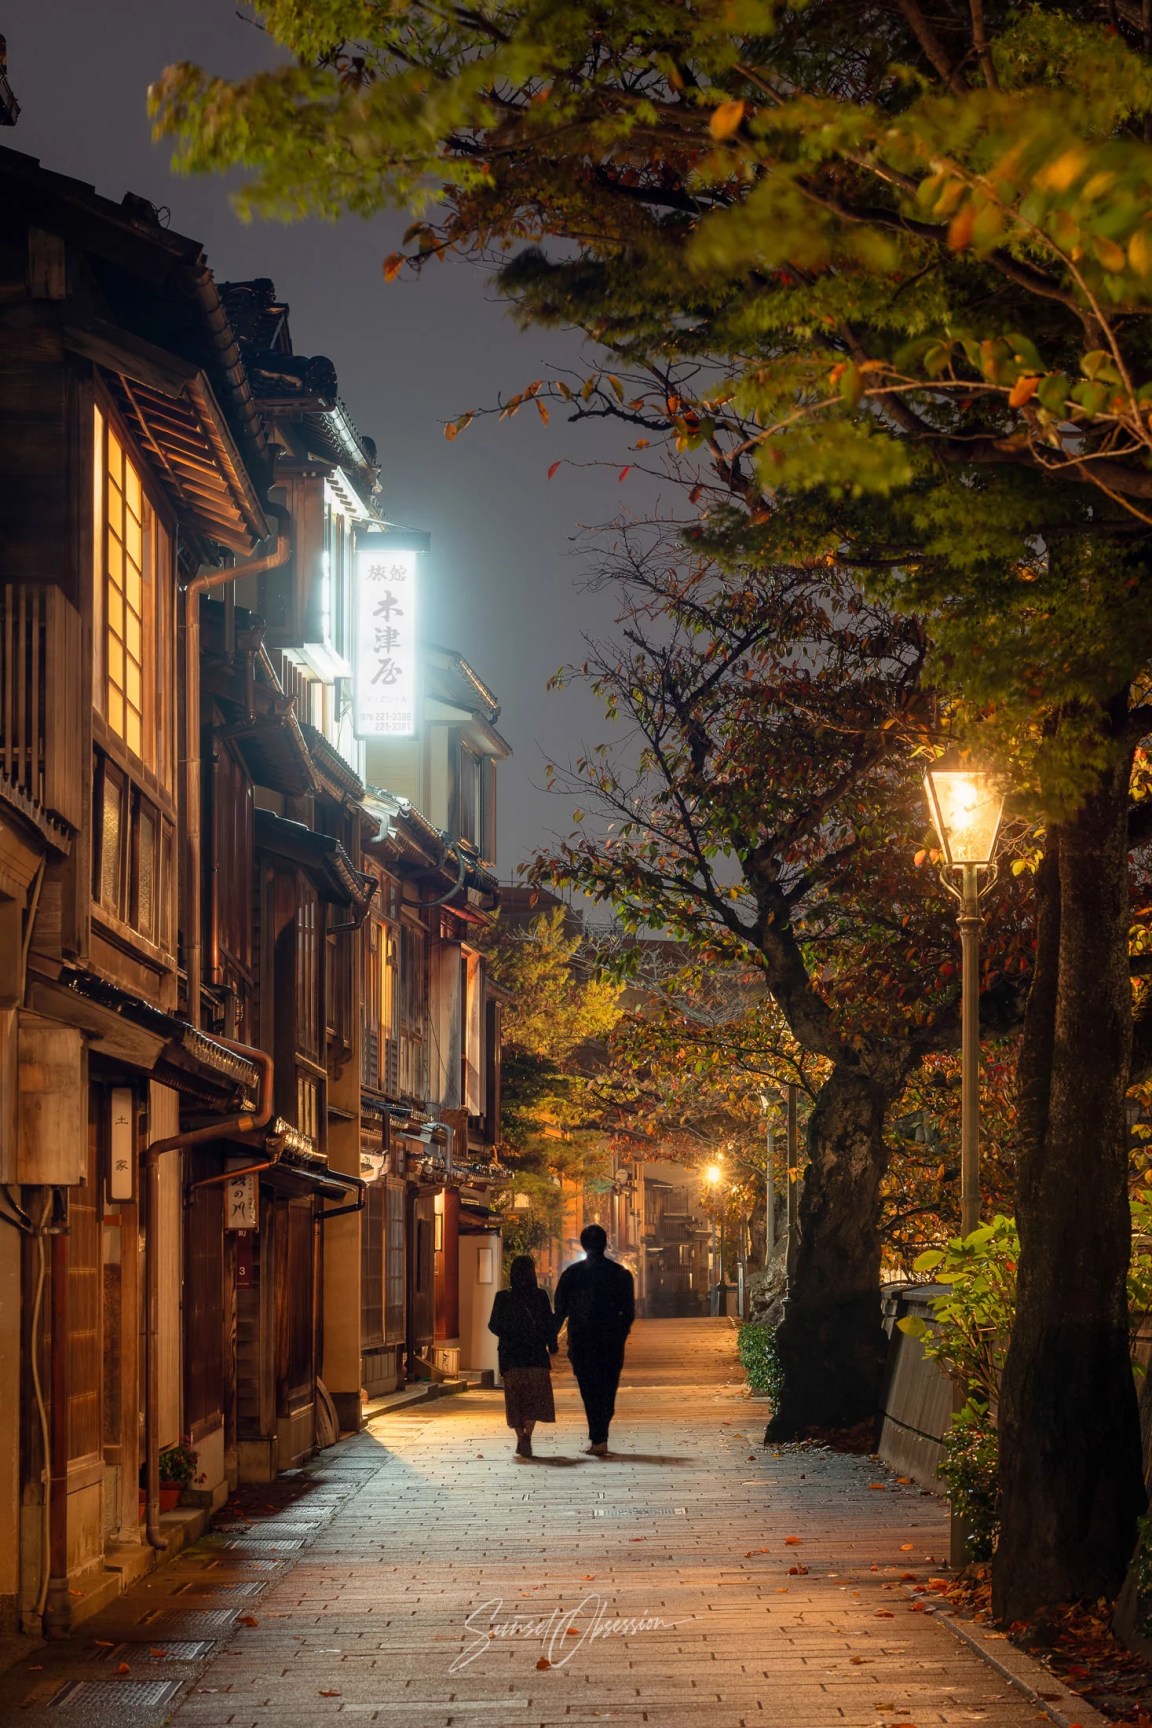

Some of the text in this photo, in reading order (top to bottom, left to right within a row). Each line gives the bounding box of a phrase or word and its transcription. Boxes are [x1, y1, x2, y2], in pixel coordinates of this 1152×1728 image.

[370, 590, 404, 686] 木津屋
[239, 1266, 246, 1276] 3
